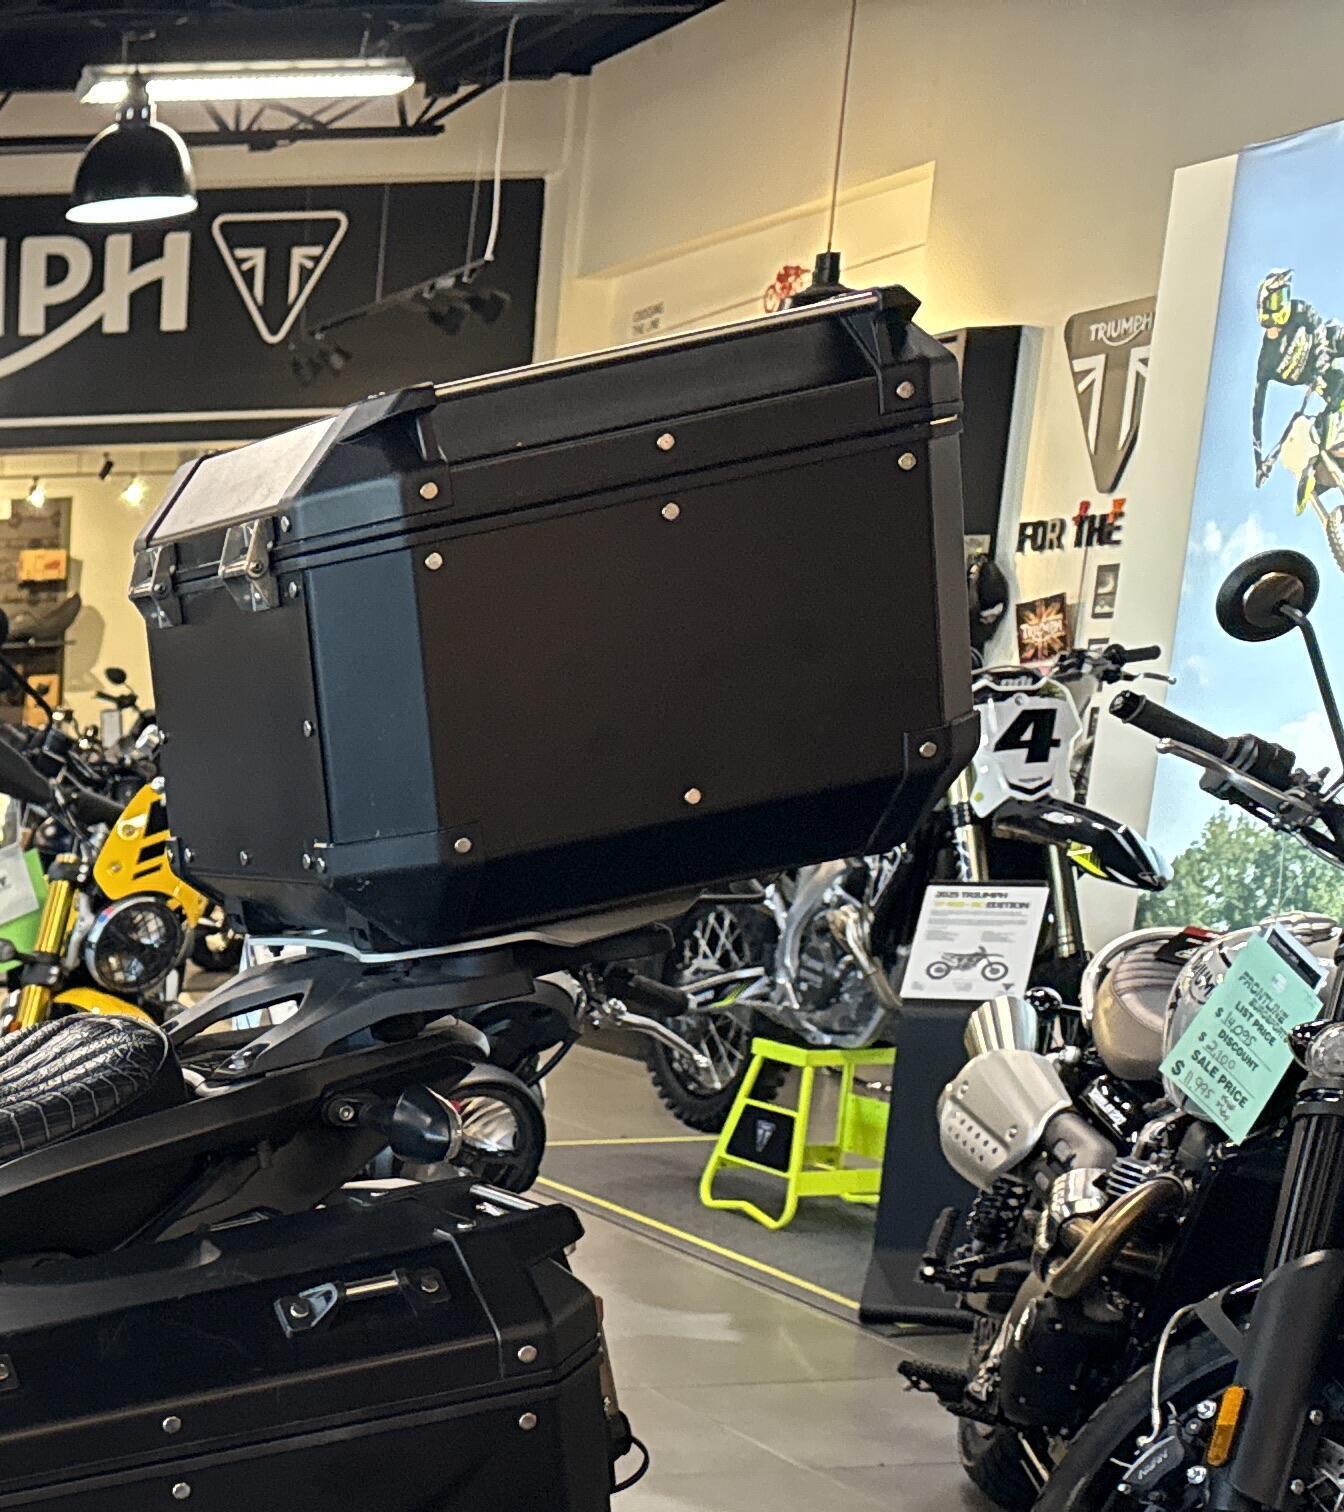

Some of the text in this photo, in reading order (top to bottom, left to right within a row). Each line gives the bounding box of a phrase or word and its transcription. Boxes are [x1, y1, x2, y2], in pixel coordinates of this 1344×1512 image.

[1089, 311, 1153, 347] TRIUMPH
[1016, 518, 1066, 553] FOR
[993, 708, 1061, 764] 4
[1215, 1007, 1224, 1018] $
[1238, 971, 1289, 1024] FRONTLINE
[1235, 1002, 1277, 1046] LIST PRICE
[1171, 1059, 1186, 1076] $
[1218, 1029, 1259, 1073] DISCOUNT
[1191, 1049, 1216, 1079] SALE
[1217, 1075, 1249, 1109] PRICE
